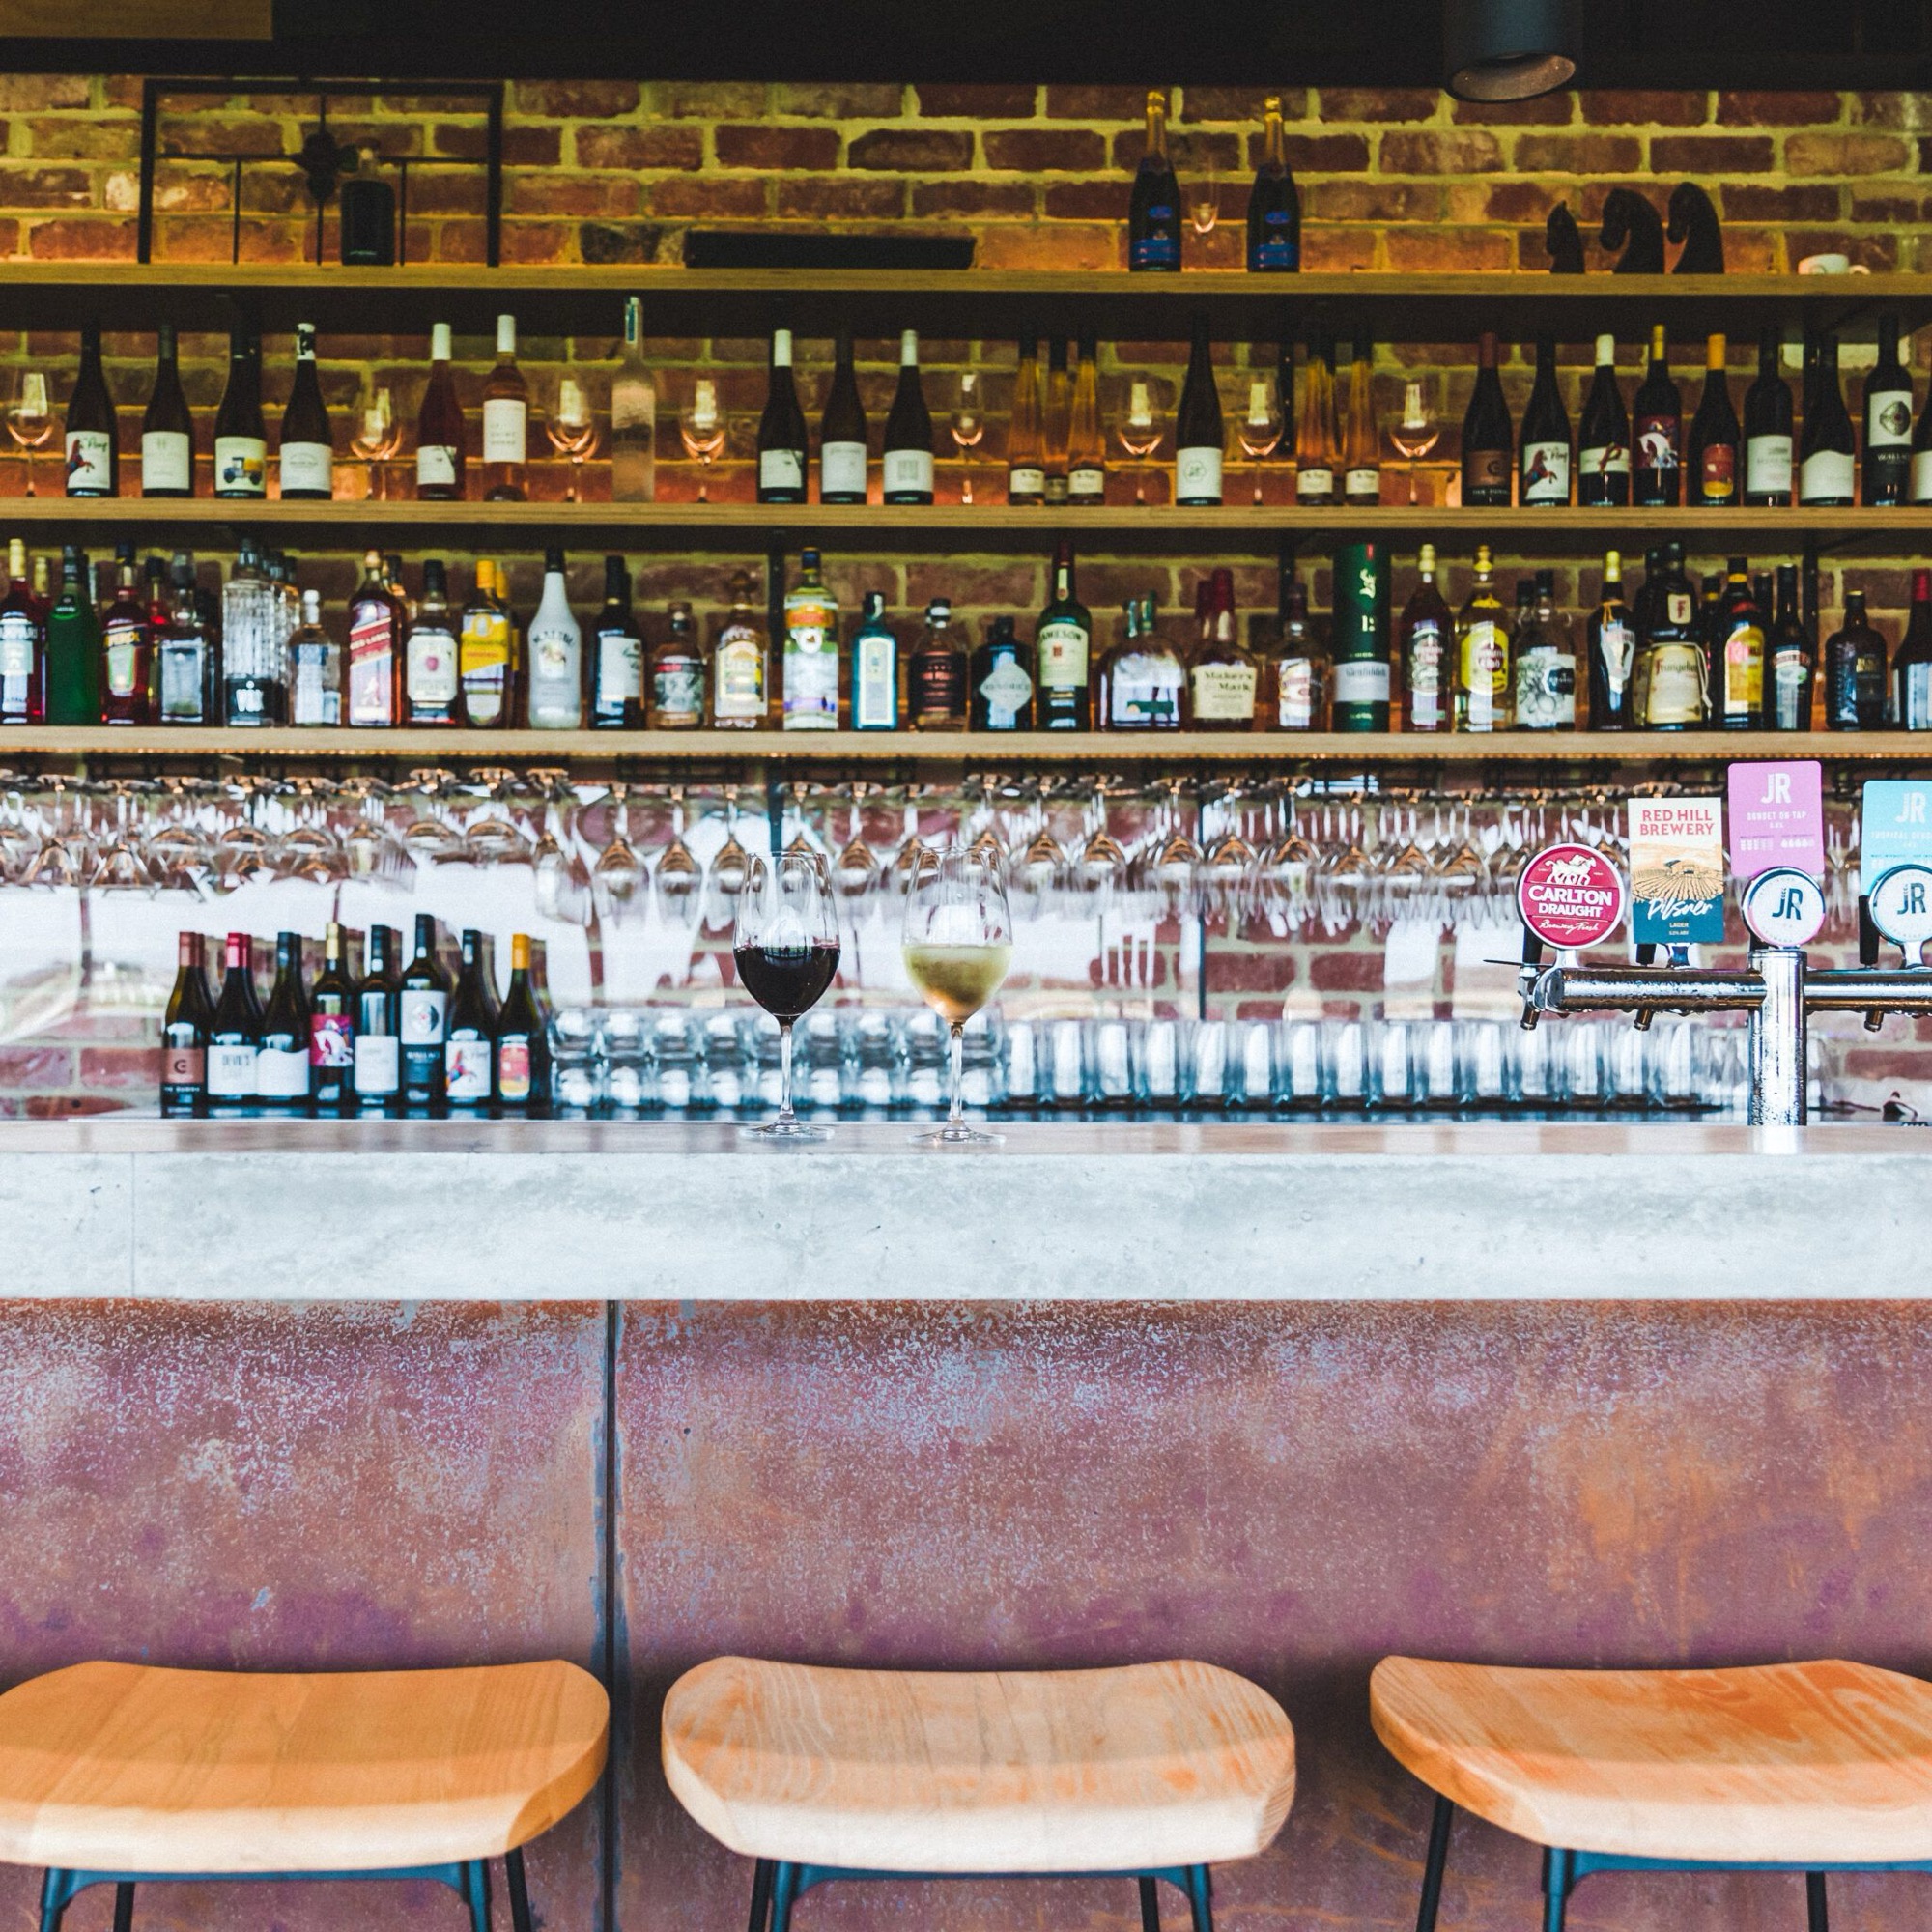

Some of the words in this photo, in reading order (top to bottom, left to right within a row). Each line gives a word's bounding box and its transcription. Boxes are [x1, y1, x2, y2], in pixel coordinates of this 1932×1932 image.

[1761, 772, 1792, 804] JR
[1642, 810, 1673, 822] RED
[1678, 809, 1713, 821] HILL
[1894, 791, 1926, 823] JR
[1639, 823, 1715, 836] BREWERY
[1528, 885, 1613, 906] CARLTON
[1771, 888, 1804, 921] JR
[1896, 883, 1926, 915] JR
[1538, 903, 1604, 918] DRAUGHT
[1647, 897, 1713, 920] Pilsner
[1539, 919, 1577, 935] Brewery
